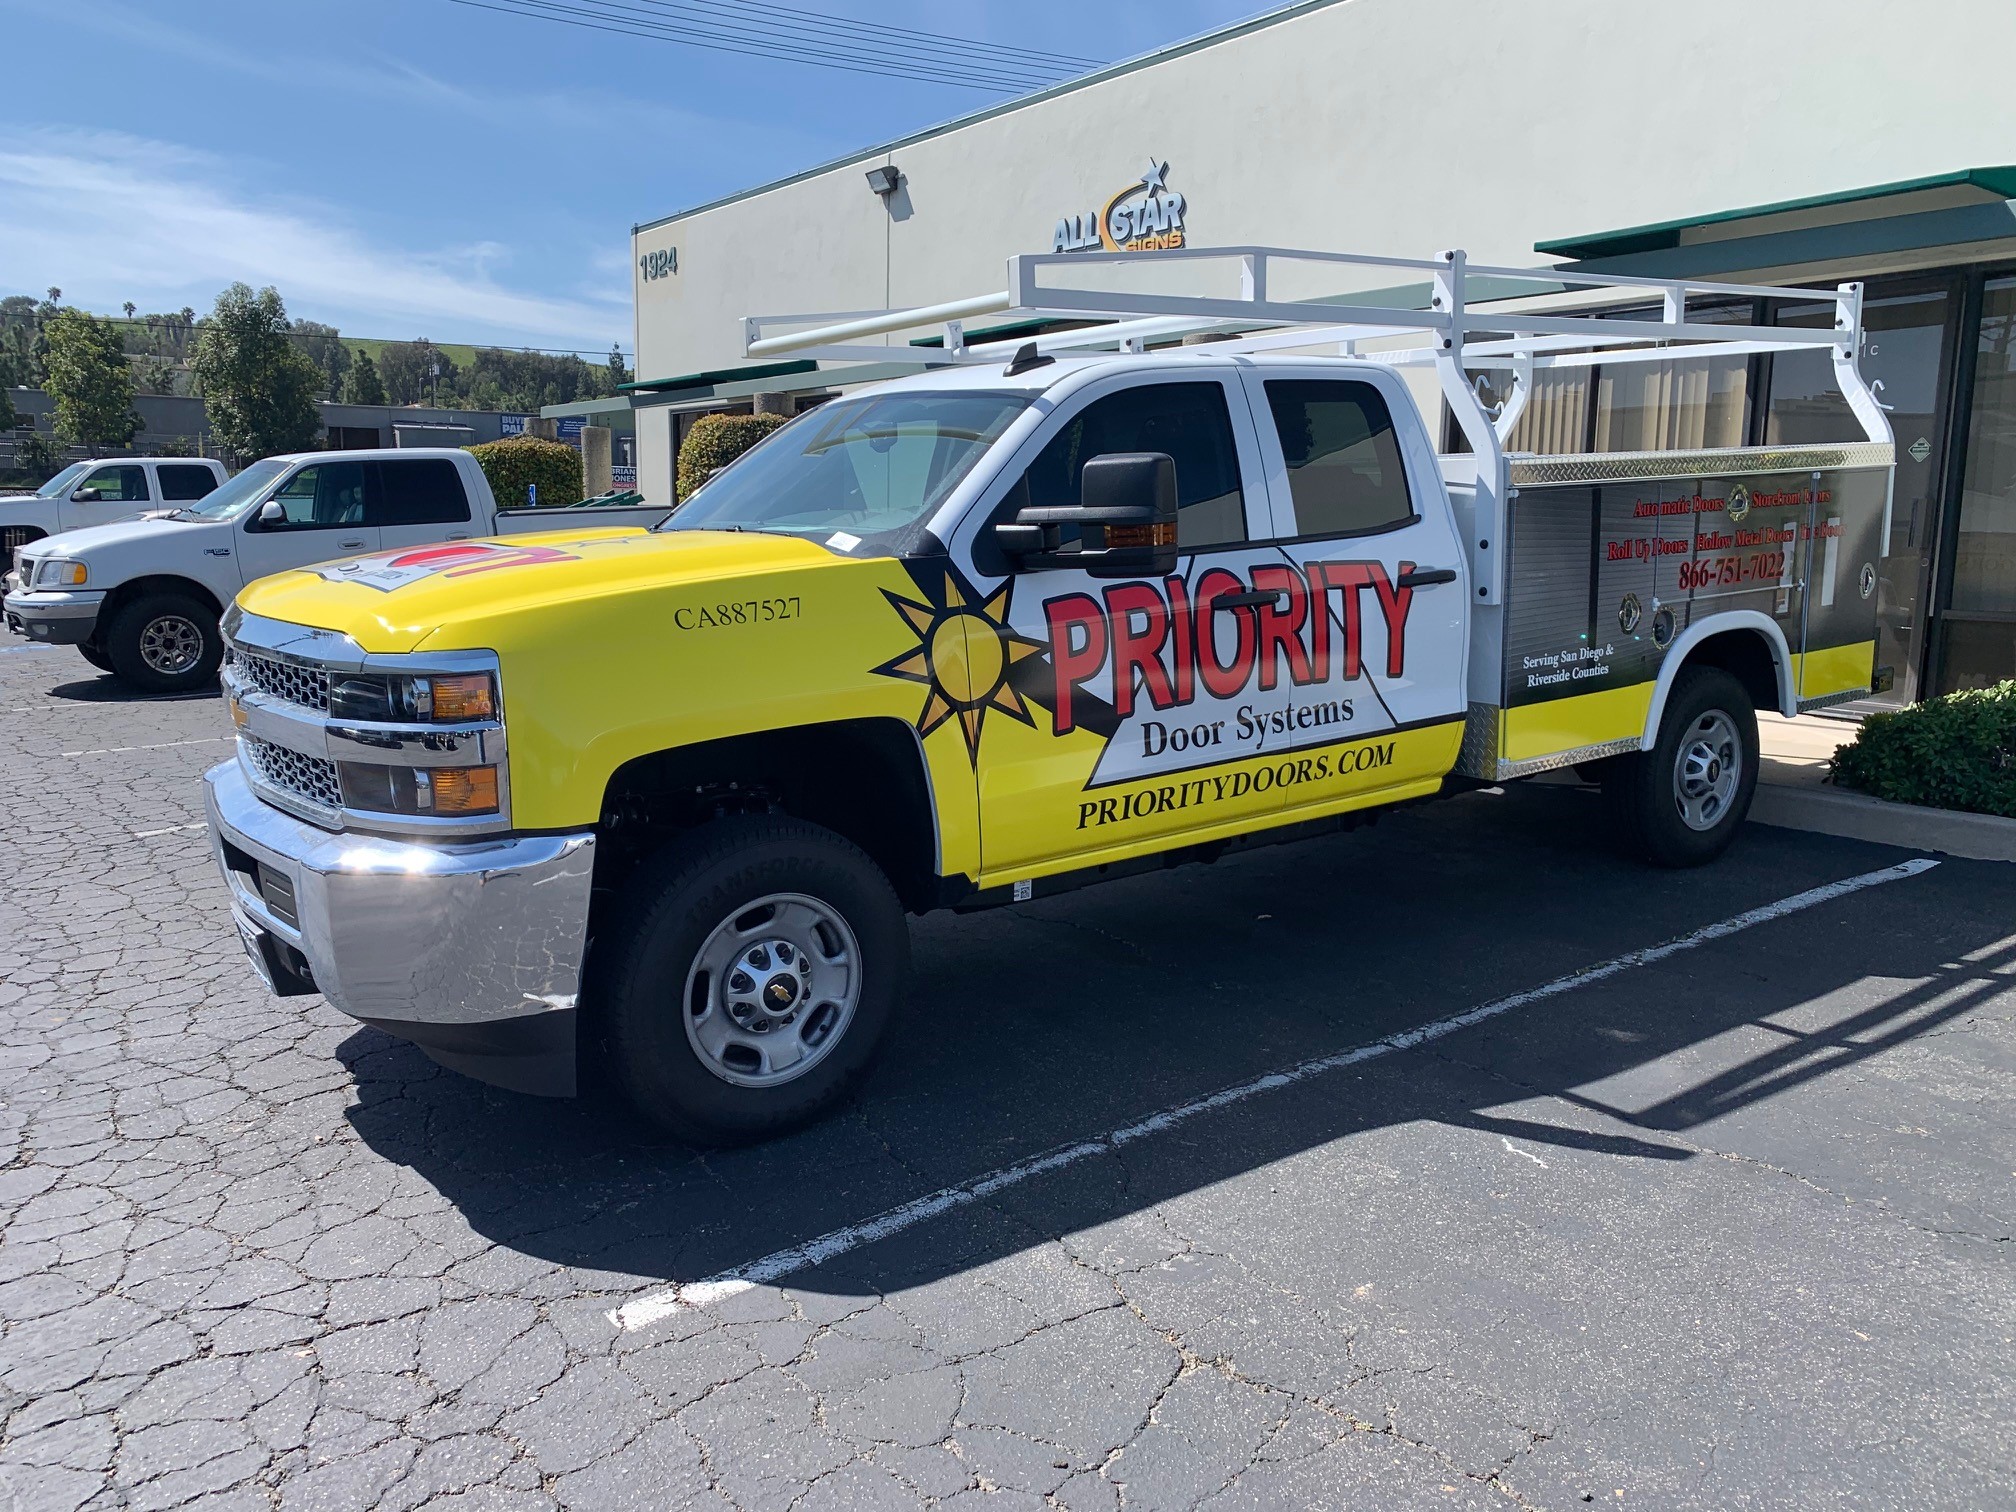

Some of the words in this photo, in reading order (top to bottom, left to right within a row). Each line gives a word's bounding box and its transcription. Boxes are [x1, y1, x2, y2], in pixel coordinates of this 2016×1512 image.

[1053, 211, 1102, 253] ALL
[1110, 191, 1186, 243] STAR
[1126, 231, 1185, 251] SIGNS
[639, 247, 678, 282] 1924
[502, 424, 525, 433] PAL
[1692, 495, 1725, 513] Doors
[1752, 488, 1801, 508] Storefront
[1607, 539, 1633, 560] Roll
[1635, 539, 1651, 563] Up
[1652, 537, 1688, 556] Doors
[1696, 531, 1733, 551] Hollow
[1735, 527, 1763, 547] Metal
[1765, 527, 1795, 544] Doors
[1820, 520, 1847, 538] Doors
[1678, 551, 1785, 590] 866-751-7022
[674, 596, 800, 630] CA887527
[1042, 560, 1417, 738] PRIORITY
[1523, 653, 1560, 669] Serving
[1561, 650, 1577, 663] San
[1579, 647, 1604, 661] Diego
[1605, 643, 1614, 656] &
[1527, 669, 1570, 687] Riverside
[1572, 663, 1609, 680] Counties
[1141, 720, 1225, 758] Door
[1236, 699, 1354, 750] Systems
[1076, 742, 1396, 830] PRIORITYDOORS.COM
